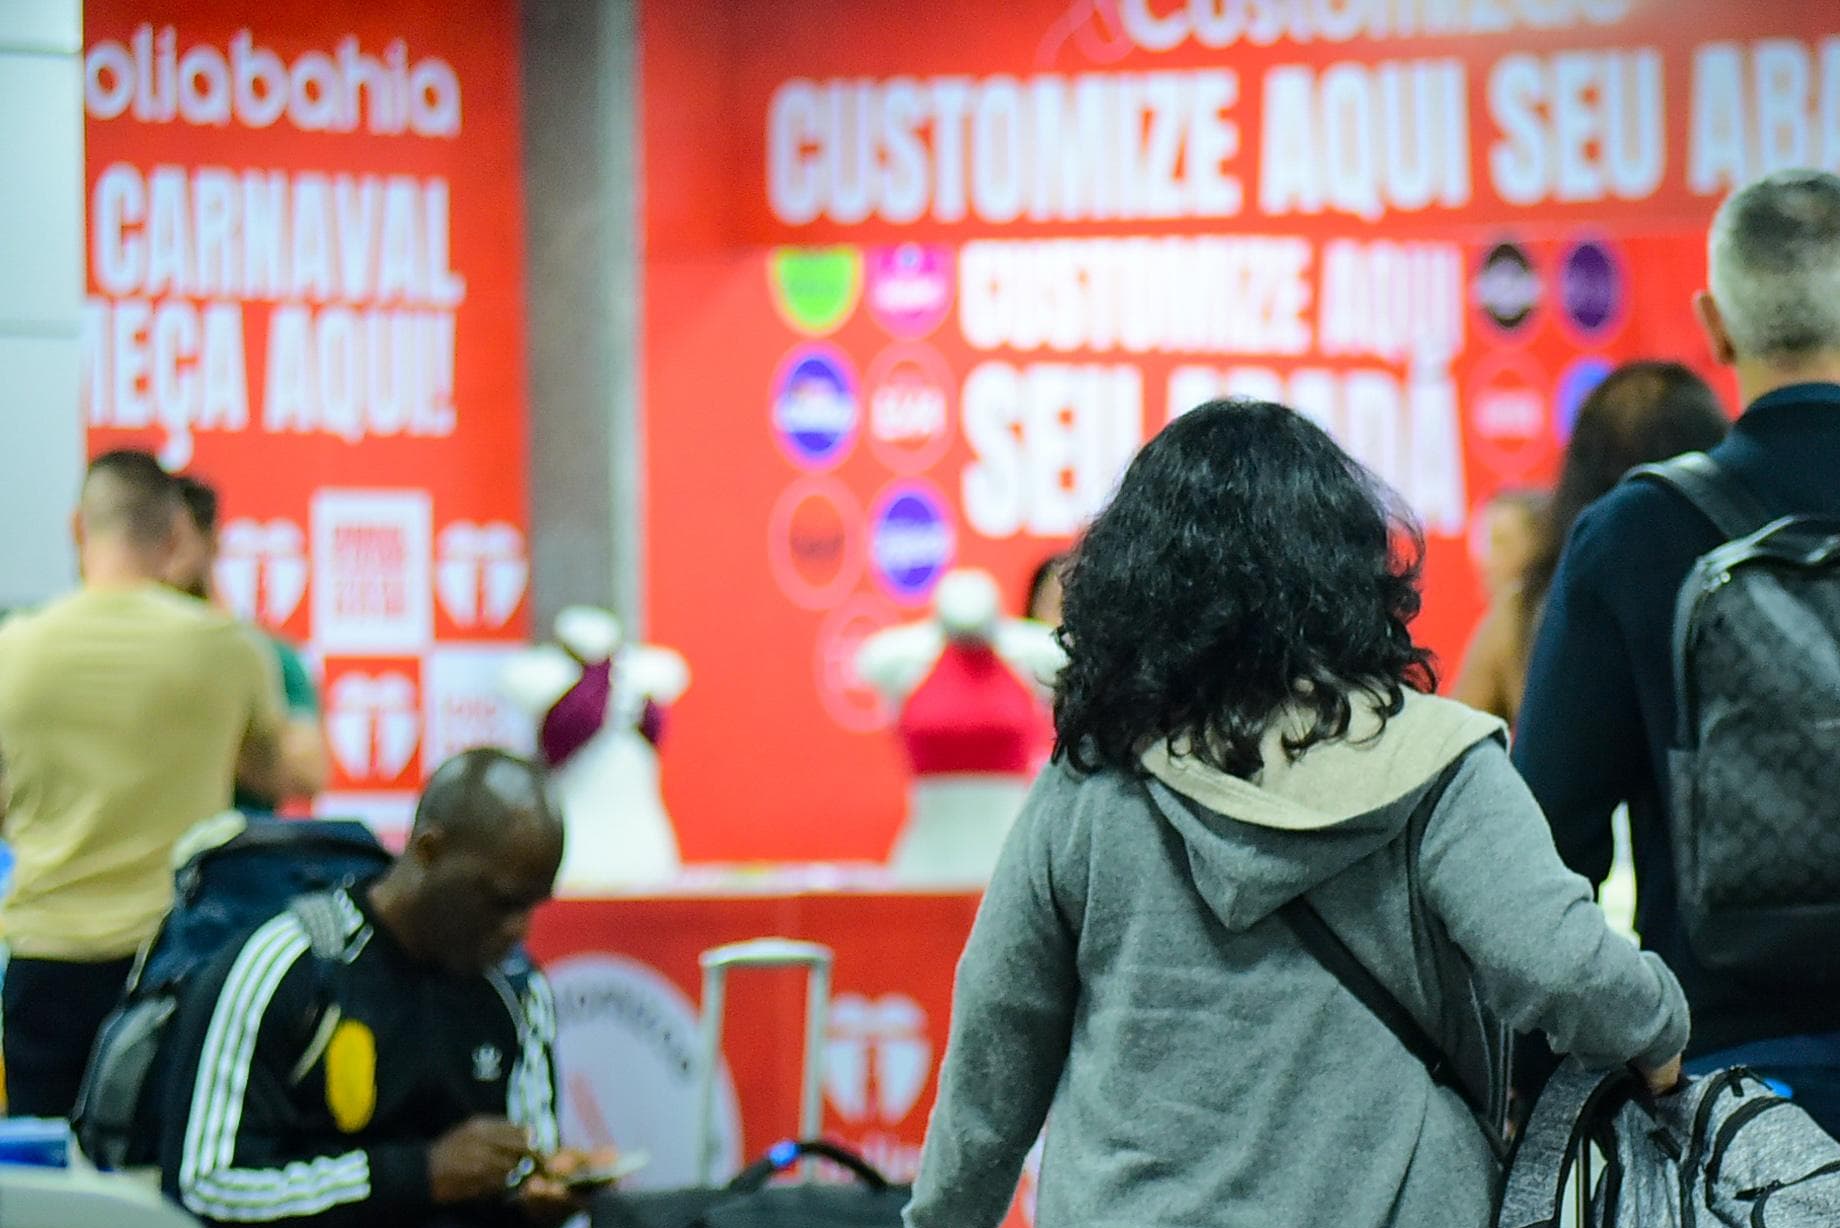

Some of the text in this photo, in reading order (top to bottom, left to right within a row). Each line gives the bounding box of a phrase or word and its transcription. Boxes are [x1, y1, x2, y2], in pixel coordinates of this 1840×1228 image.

[767, 70, 1242, 224] CUSTOMIZE
[1260, 58, 1472, 220] AQUI
[1487, 48, 1668, 205] SEU
